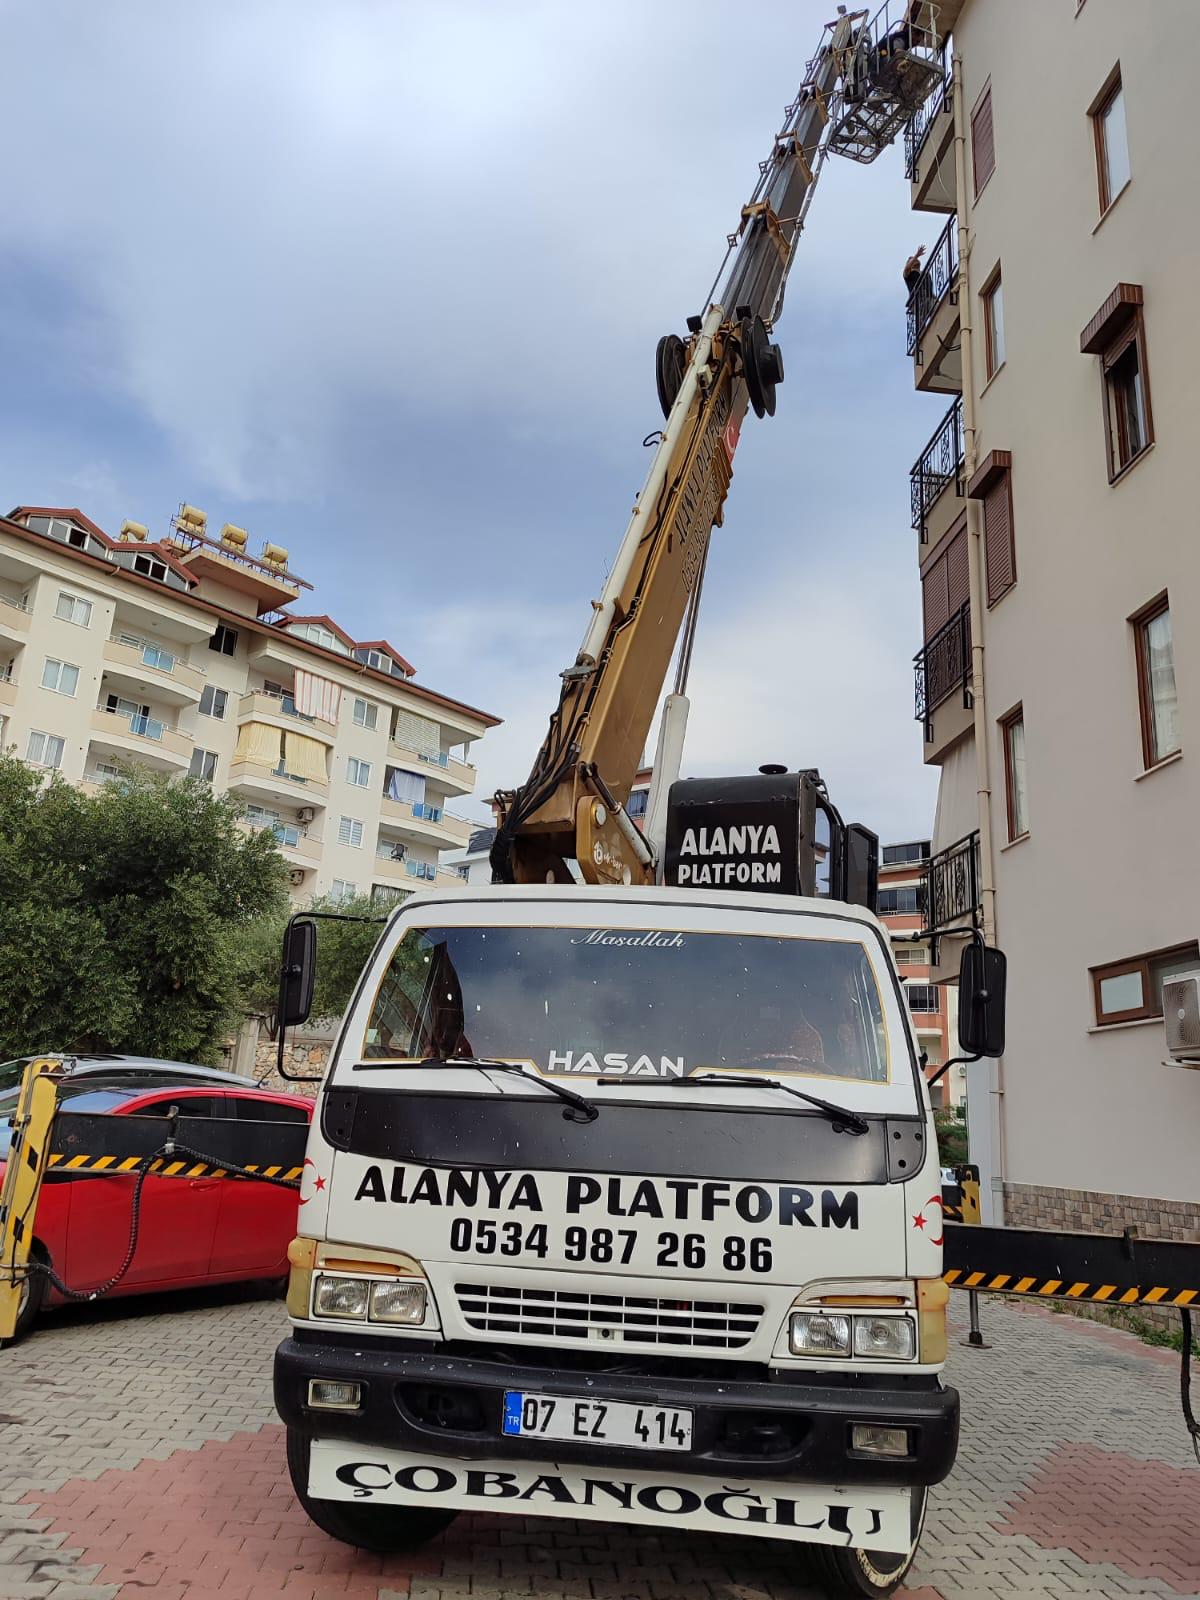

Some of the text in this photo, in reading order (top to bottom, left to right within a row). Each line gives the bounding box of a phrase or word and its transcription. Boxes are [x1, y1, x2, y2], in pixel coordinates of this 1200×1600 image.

[679, 824, 781, 856] ALANYA
[677, 862, 781, 885] PLATFORM
[547, 1050, 684, 1077] HASAN
[354, 1165, 859, 1230] ALANYA PLATFORM
[450, 1217, 773, 1273] 0534 987 26 86
[507, 1415, 520, 1426] TR
[522, 1398, 686, 1446] 07 EZ 414
[335, 1462, 884, 1536] ÇOBANOĞLU
